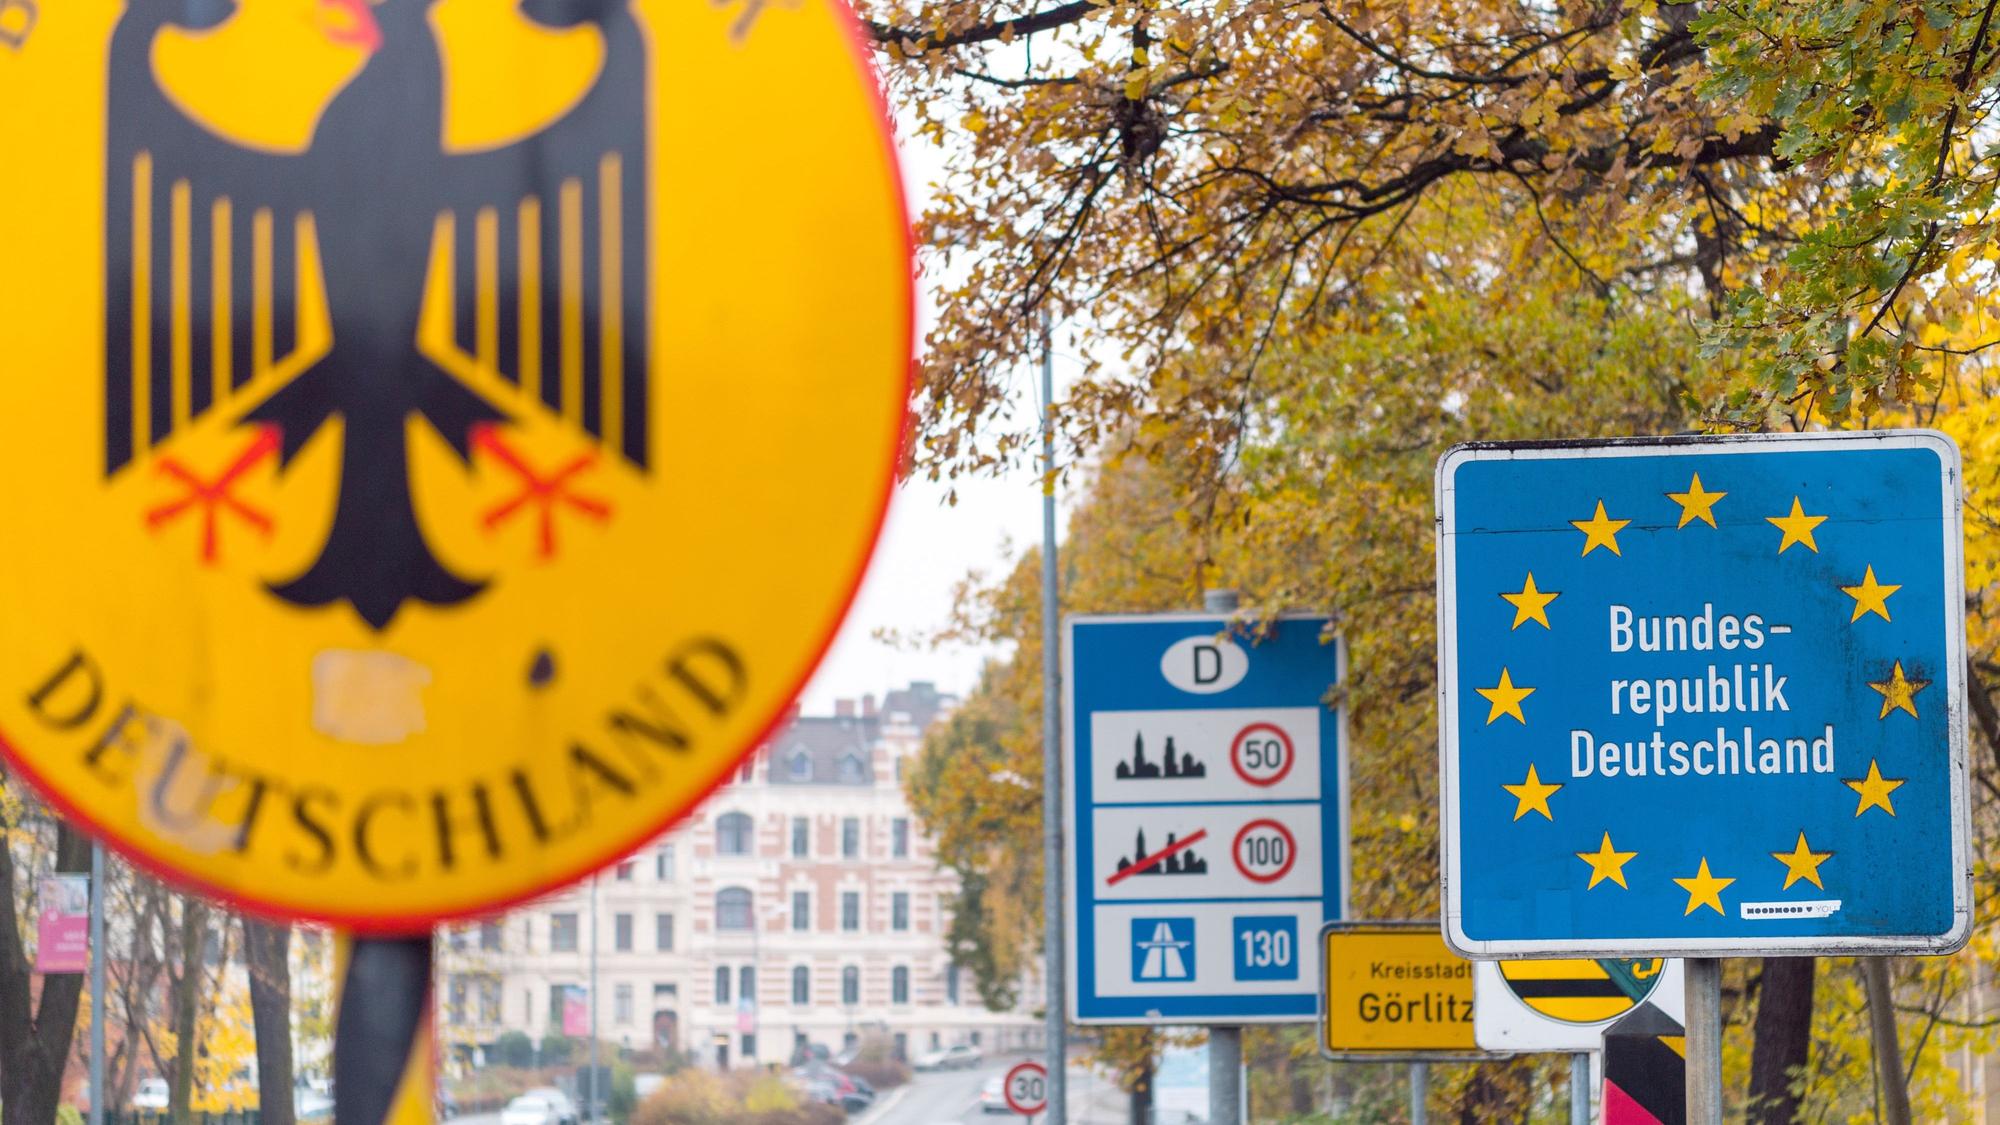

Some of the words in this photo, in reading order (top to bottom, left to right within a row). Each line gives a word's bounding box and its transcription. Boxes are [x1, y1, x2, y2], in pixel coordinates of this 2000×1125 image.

[1610, 603, 1792, 652] Bundes-
[1194, 645, 1222, 685] D
[1611, 664, 1790, 726] republik
[27, 636, 749, 880] DEUTSCHLAND
[1245, 740, 1281, 769] 50
[1571, 725, 1835, 778] Deutschland
[1246, 837, 1284, 866] 100
[1241, 930, 1290, 967] 130
[1359, 992, 1474, 1023] Görlitz
[1015, 1077, 1045, 1100] 30
